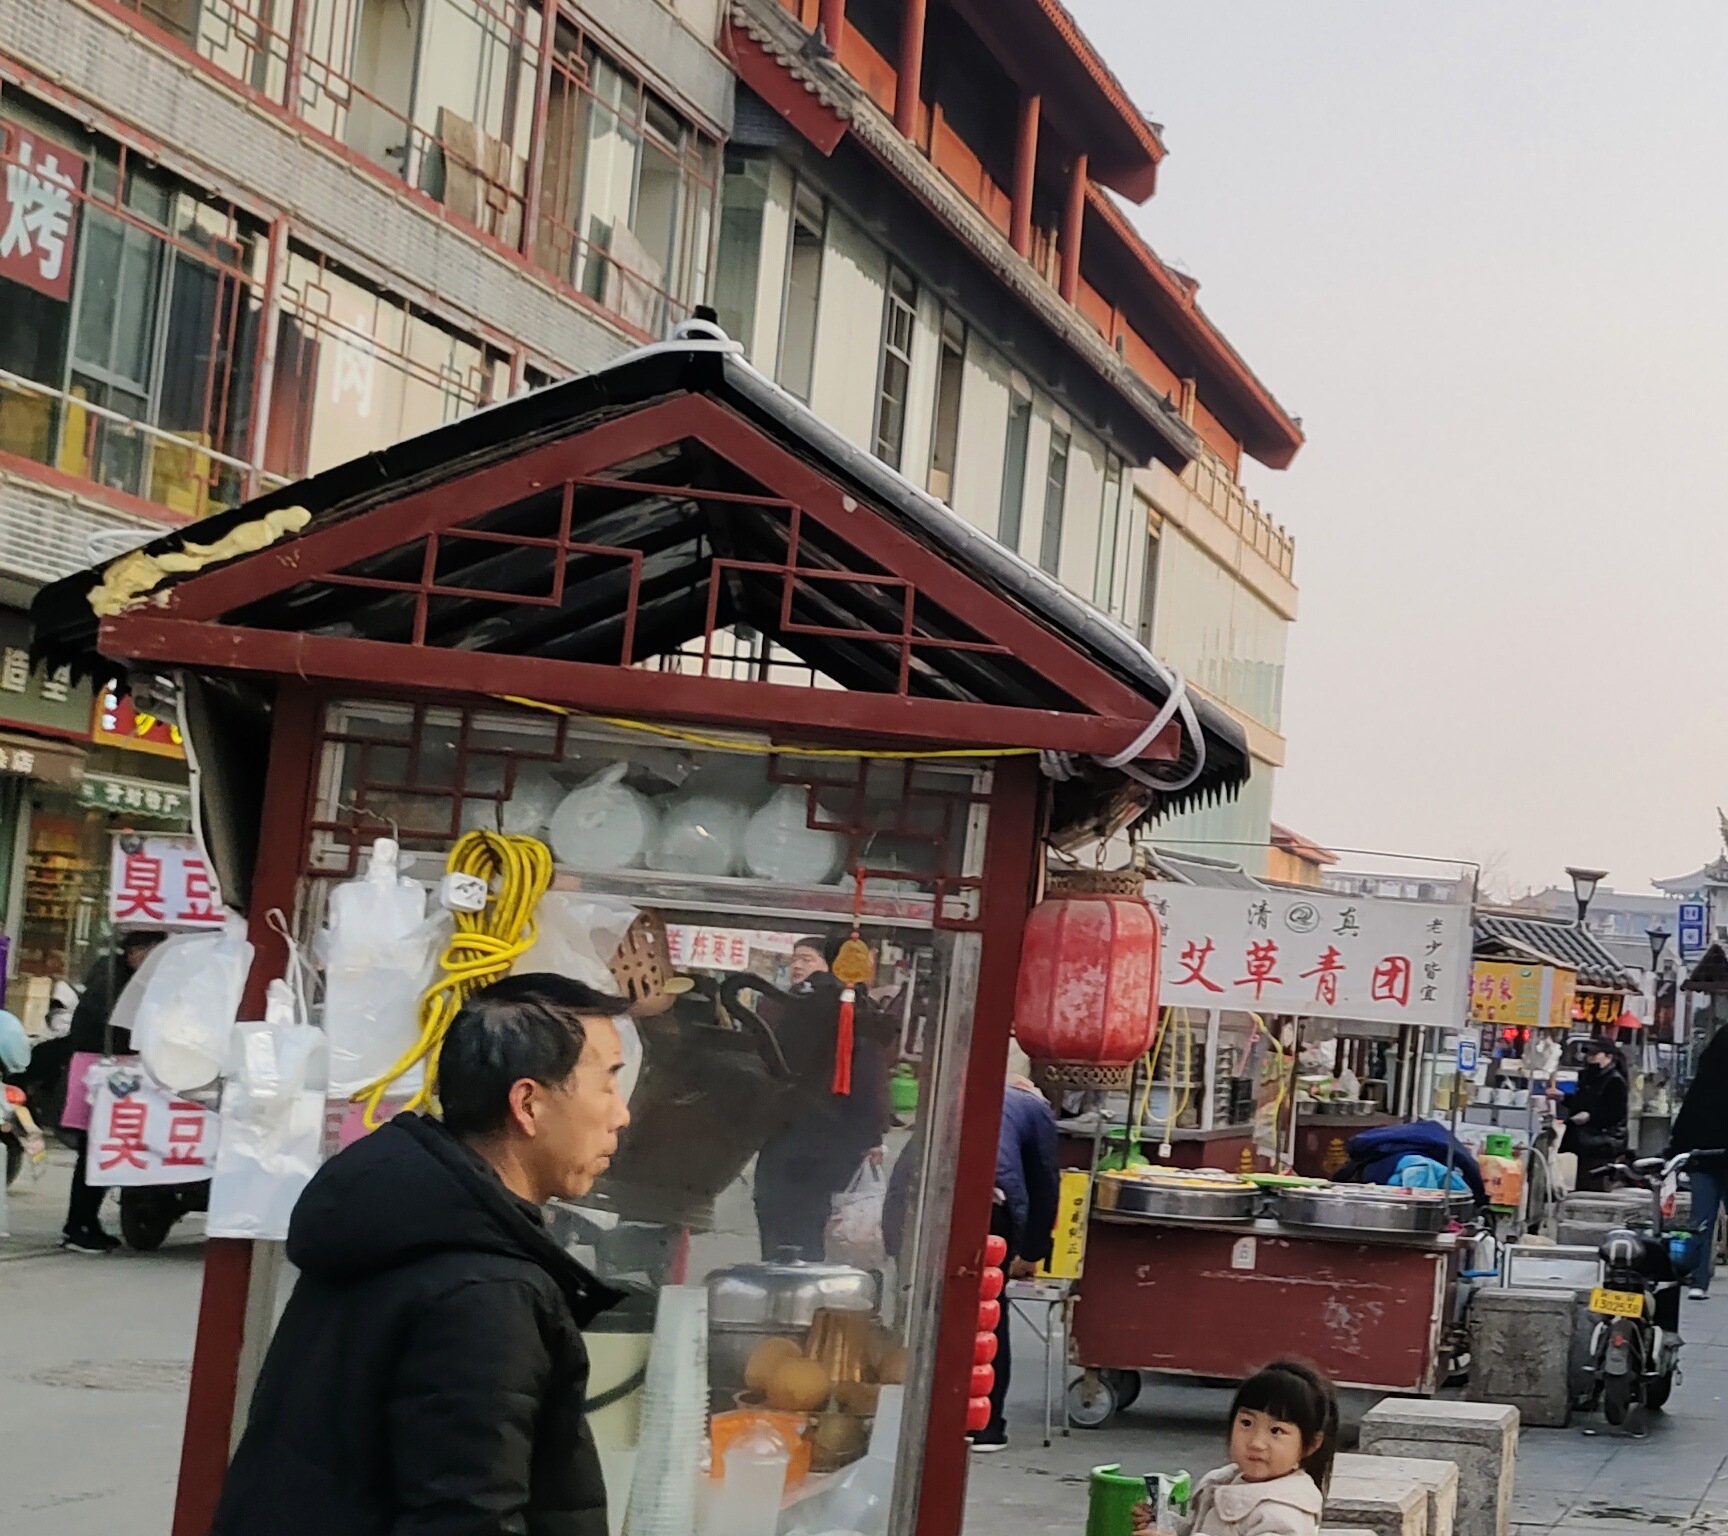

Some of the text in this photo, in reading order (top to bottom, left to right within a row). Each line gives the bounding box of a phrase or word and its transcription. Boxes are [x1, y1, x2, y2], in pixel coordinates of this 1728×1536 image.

[0, 141, 76, 280] 烤
[1169, 936, 1412, 1008] 艾草青团
[1419, 917, 1443, 1003] 老少皆宜
